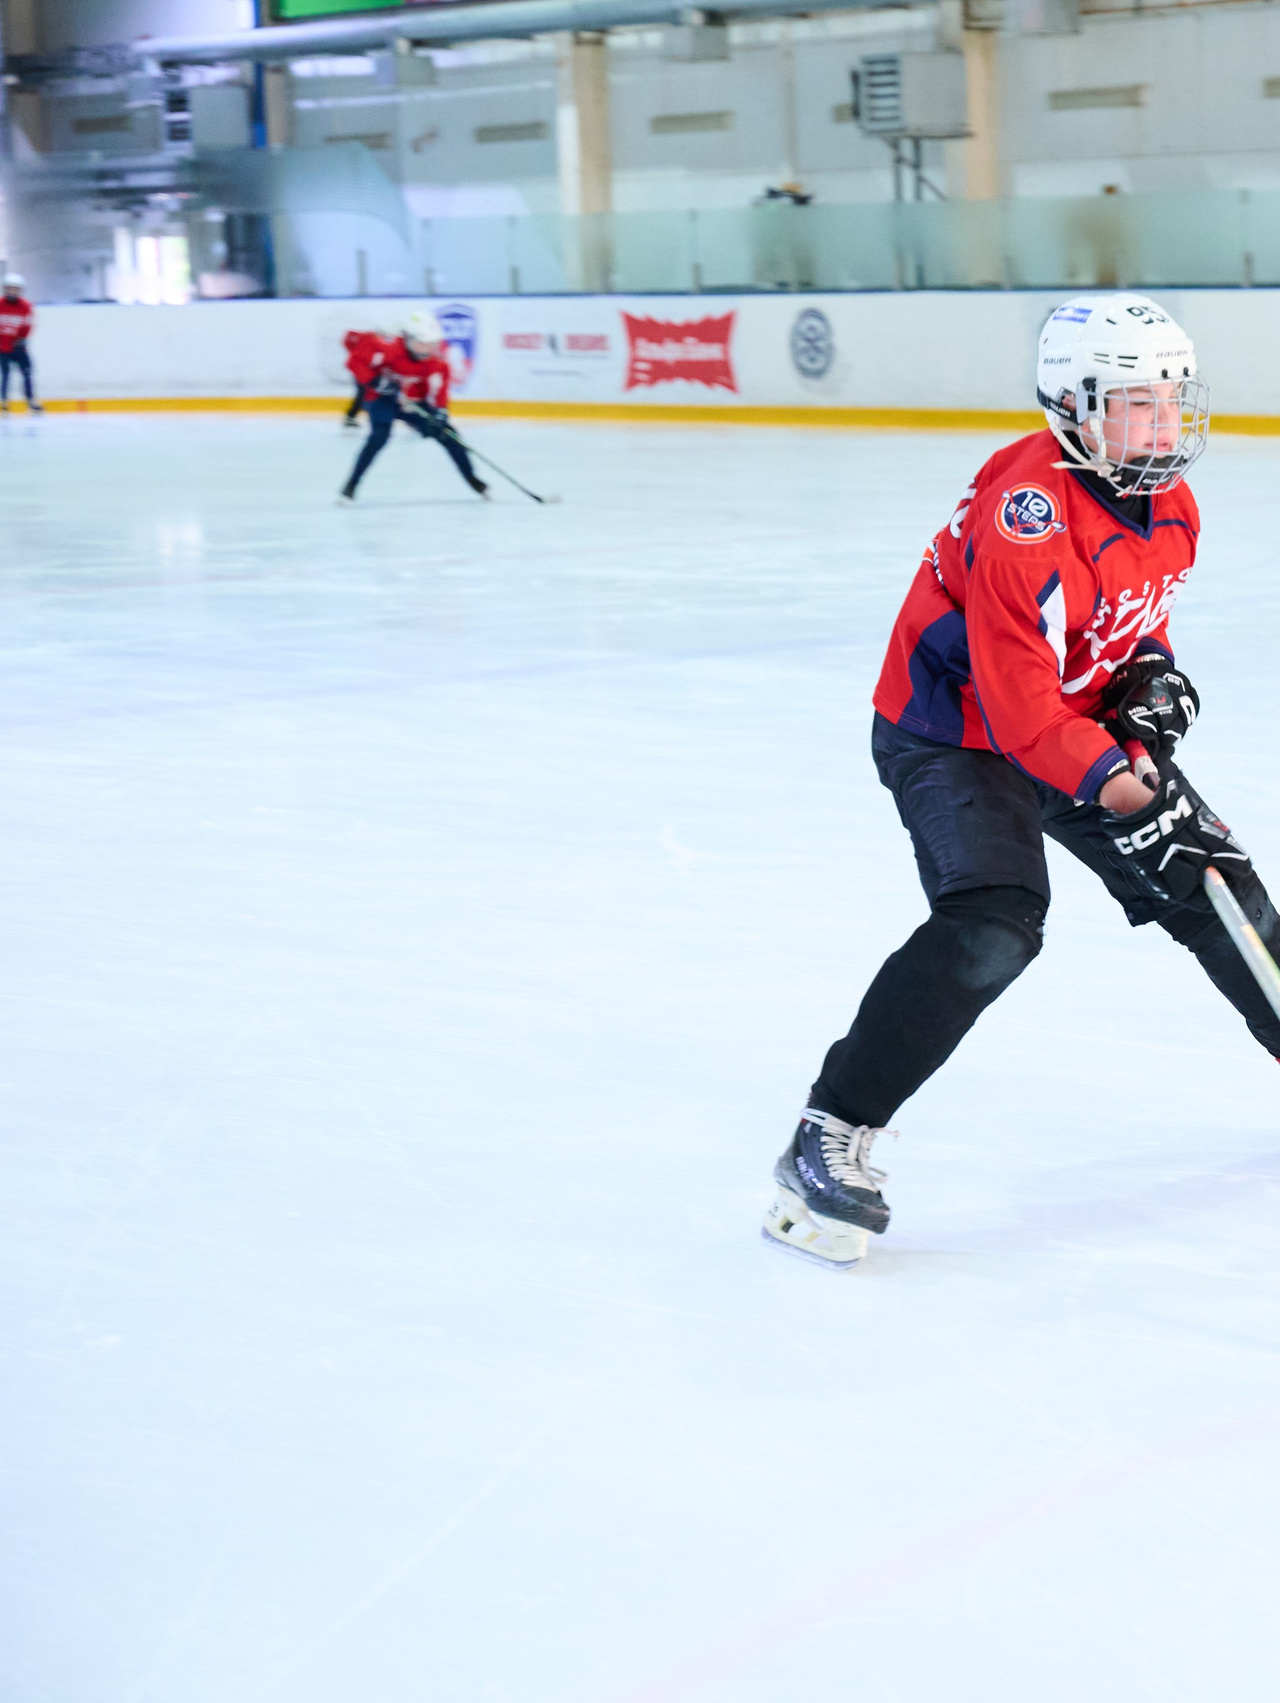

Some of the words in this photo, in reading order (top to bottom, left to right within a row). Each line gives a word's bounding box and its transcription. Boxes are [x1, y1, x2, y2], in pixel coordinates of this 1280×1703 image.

[1043, 357, 1071, 365] BAUER
[1007, 503, 1046, 531] STEPS
[1021, 491, 1048, 518] 10
[1113, 794, 1193, 855] CCM
